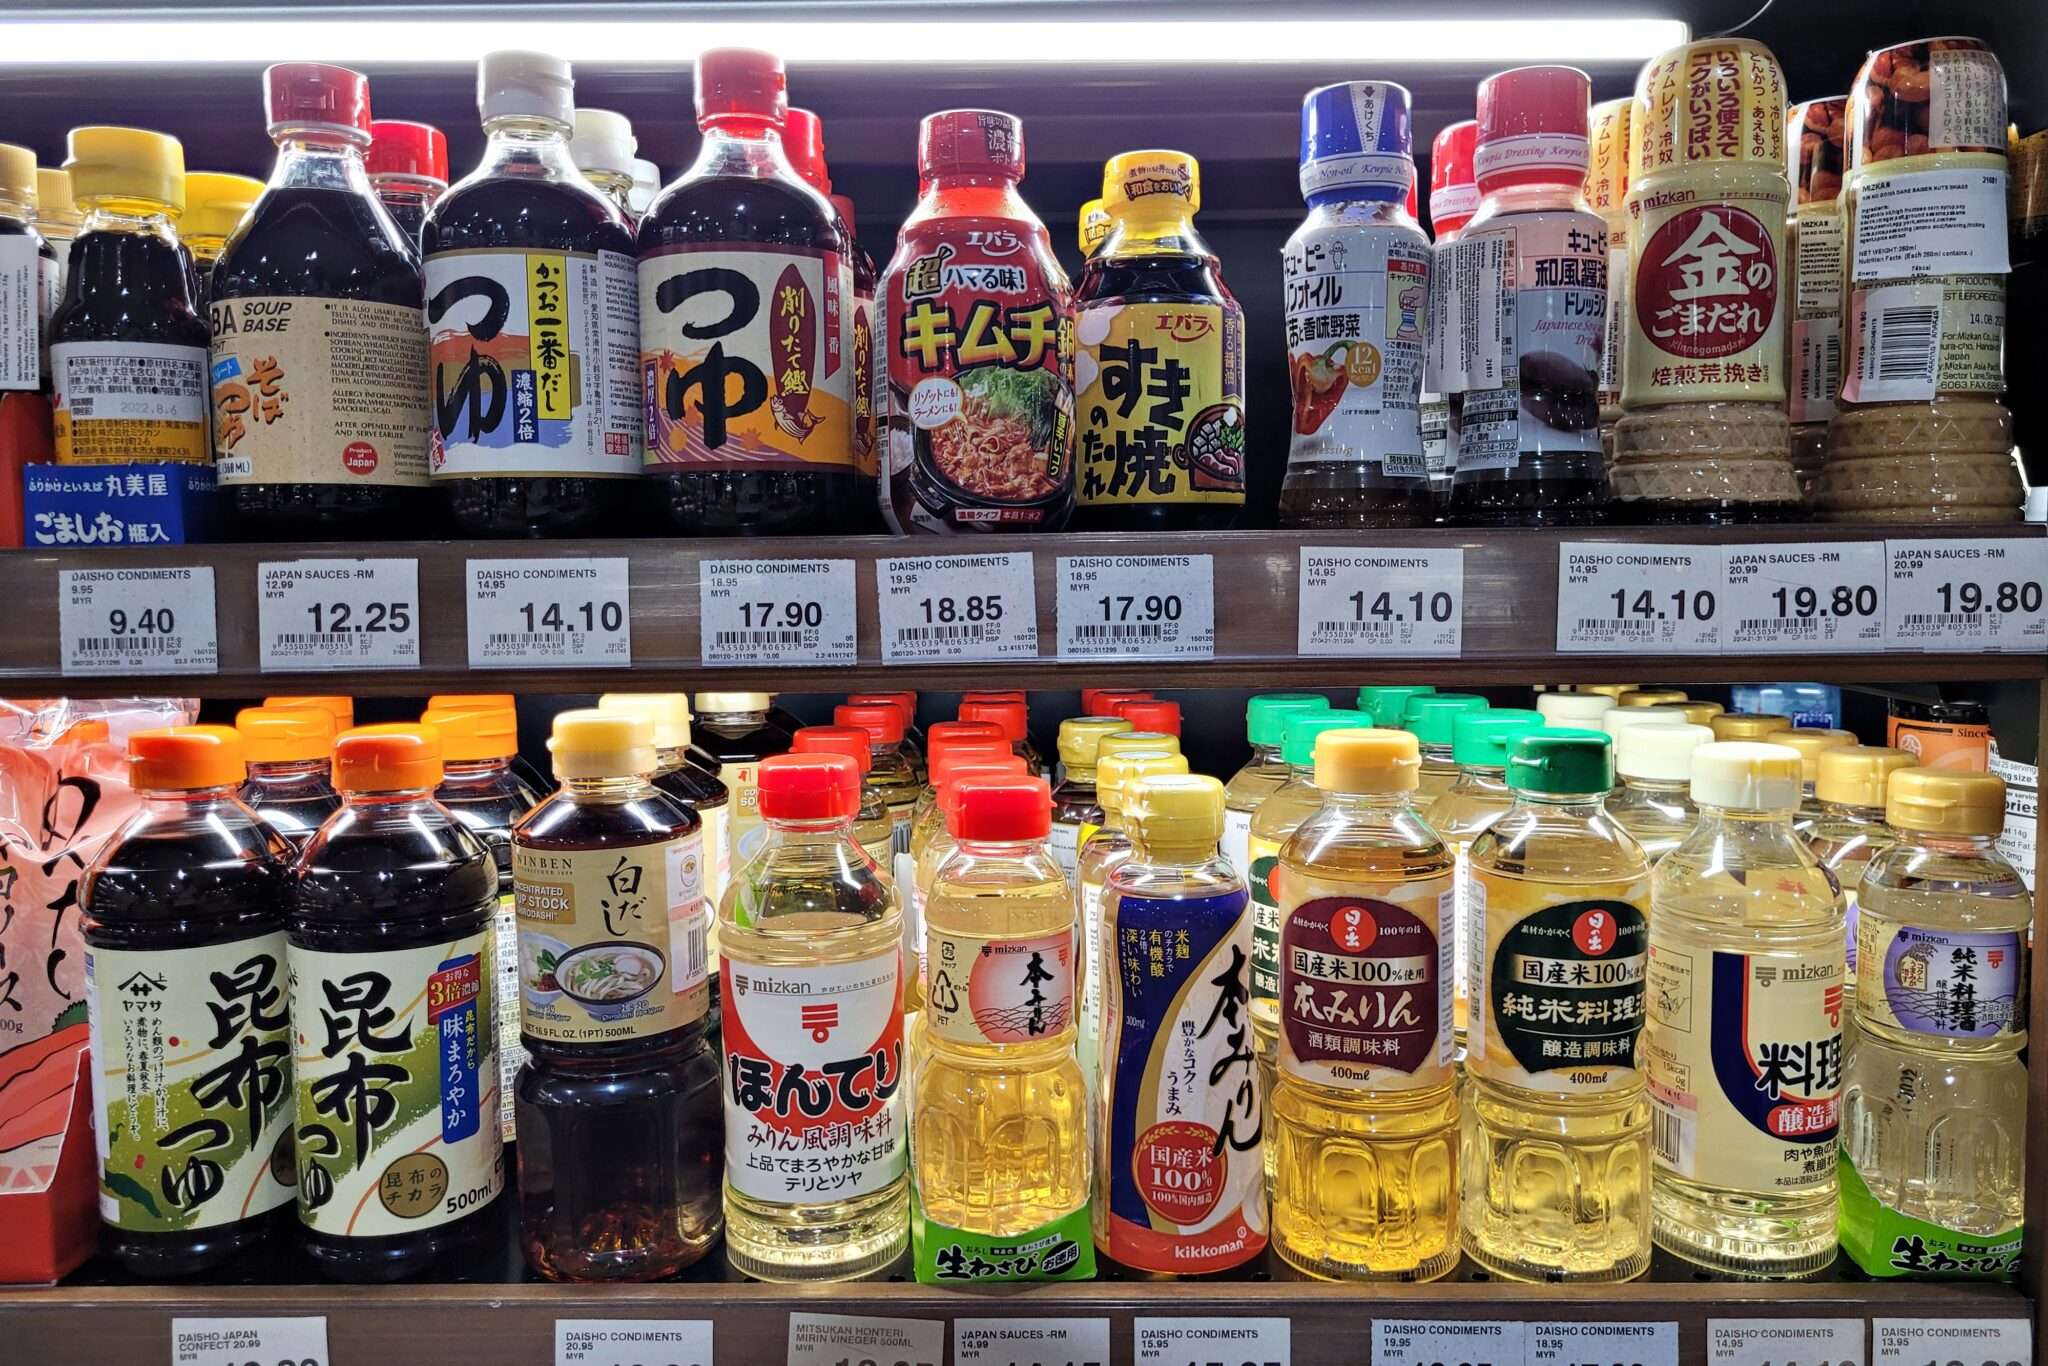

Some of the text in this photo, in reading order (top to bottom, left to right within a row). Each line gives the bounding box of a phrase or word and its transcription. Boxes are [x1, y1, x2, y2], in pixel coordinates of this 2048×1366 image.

[1688, 53, 1712, 161] コクがいっぱい
[1716, 51, 1739, 158] いろいろ使えて
[1750, 52, 1765, 158] とんかつ・あえもの
[1364, 100, 1374, 142] あけくち
[1644, 189, 1695, 209] mizkan
[966, 231, 1019, 246] エバラ
[1661, 211, 1772, 301] 金の
[243, 302, 292, 316] SOUP
[827, 276, 839, 354] 風味一番
[243, 318, 290, 332] BASE
[1155, 314, 1212, 333] エバラ
[1533, 319, 1583, 332] Japanese
[1652, 301, 1764, 337] ごまだれ
[535, 262, 565, 412] かつお一番だし
[780, 286, 810, 397] 削りたて鰹
[903, 302, 1057, 367] キムチ
[427, 276, 510, 444] つゆ
[656, 267, 768, 450] つゆ
[1353, 346, 1372, 365] 12
[1944, 352, 1970, 361] Japan
[1351, 363, 1376, 375] kcal
[1651, 363, 1762, 386] 焙煎荒挽き
[247, 356, 289, 425] そば
[332, 390, 363, 399] ALLERGY
[914, 387, 958, 406] リゾットにも!
[120, 401, 177, 416] 2022.8.6
[515, 372, 534, 441] 濃縮2倍
[914, 404, 957, 420] ラーメンにも!
[347, 457, 376, 468] Japan
[29, 474, 169, 497] ふりかけといえば 丸美屋
[34, 512, 170, 545] ごましお 瓶入
[1070, 557, 1190, 568] DAISHO CONDIMENTS
[1569, 555, 1692, 565] DAISHO CONDIMENTS
[1729, 555, 1766, 564] JAPAN
[1769, 553, 1815, 563] SAUCES
[1894, 550, 1931, 559] JAPAN
[1934, 549, 1980, 559] SAUCES
[710, 564, 830, 574] DAISHO CONDIMENTS
[890, 557, 1009, 571] DAISHO CONDIMENTS
[1308, 558, 1428, 568] DAISHO CONDIMENTS
[1569, 566, 1598, 574] 14.95
[1729, 566, 1758, 575] 20.99
[1894, 561, 1923, 569] 20.99
[72, 570, 191, 581] DAISHO CONDIMENTS
[265, 570, 301, 579] JAPAN
[305, 570, 350, 579] SAUCES
[477, 569, 597, 579] DAISHO CONDIMENTS
[890, 575, 918, 584] 19.95
[1070, 572, 1097, 581] 18.95
[1308, 568, 1336, 577] 14.95
[72, 585, 93, 594] 9.95
[266, 581, 293, 589] 12.99
[478, 581, 505, 589] 14.95
[711, 578, 738, 587] 18.95
[1611, 589, 1715, 621] 14.10
[1772, 585, 1878, 618] 19.80
[1937, 582, 2043, 613] 19.80
[739, 602, 822, 628] 17.90
[920, 595, 1002, 623] 18.85
[1099, 595, 1182, 621] 17.90
[1350, 591, 1452, 622] 14.10
[110, 608, 175, 635] 9.40
[308, 602, 410, 633] 12.25
[520, 602, 622, 632] 14.10
[1957, 727, 1986, 739] Since
[2012, 828, 2027, 838] 14g
[528, 896, 569, 910] STOCK
[600, 856, 647, 937] 白だし
[1175, 929, 1190, 960] 米麹
[1911, 932, 1949, 945] mizkan
[995, 945, 1027, 954] mizkan
[1149, 929, 1165, 978] 有機酸
[1126, 928, 1143, 998] 深い味わい
[1294, 950, 1424, 982] 国産米100%使用
[1782, 963, 1834, 981] mizkan
[429, 980, 481, 1008] 3倍濃縮
[753, 978, 811, 995] mizkan
[1949, 946, 1978, 1034] 純米料理酒
[122, 999, 162, 1013] ヤマサ
[1293, 981, 1421, 1029] 本みりん
[465, 1008, 476, 1071] 昆布だから
[605, 1026, 636, 1037] 500ML
[1308, 1031, 1401, 1056] 酒類調味料
[1542, 1036, 1631, 1059] 醸造調味料
[1181, 1020, 1198, 1094] 豊かなコクと
[442, 1013, 466, 1130] 味まろやか
[729, 1040, 902, 1116] ほんてり
[1166, 1071, 1181, 1116] うまみ
[747, 1109, 893, 1151] みりん風調味料
[746, 1138, 896, 1172] 上品でまろやかな甘味
[1150, 1144, 1213, 1168] 国産米
[785, 1171, 863, 1192] テリとツヤ
[1151, 1167, 1212, 1191] 100%
[446, 1180, 492, 1214] 500ml
[1175, 1238, 1243, 1259] kikkoman
[1890, 1234, 2005, 1273] 生わさび
[936, 1244, 1040, 1280] 生わさび
[179, 1330, 257, 1342] DAISHO JAPAN
[566, 1332, 682, 1341] DAISHO CONDIMENTS
[797, 1325, 904, 1337] MITSUKAN HONTERI
[962, 1331, 996, 1339] JAPAN
[1000, 1330, 1043, 1339] SAUCES
[1141, 1330, 1258, 1339] DAISHO CONDIMENTS
[1384, 1325, 1502, 1335] DAISHO CONDIMENTS
[1536, 1326, 1655, 1336] DAISHO CONDIMENTS
[1715, 1329, 1834, 1338] DAISHO CONDIMENTS
[1881, 1327, 2000, 1337] DAISHO CONDIMENTS
[179, 1340, 260, 1351] CONFECT 20.99
[566, 1342, 593, 1350] 20.95
[797, 1334, 912, 1347] MIRIN VINEGER 500ML
[962, 1340, 988, 1348] 14.99
[1141, 1340, 1169, 1348] 15.95
[1384, 1338, 1411, 1347] 19.95
[1536, 1340, 1563, 1349] 18.95
[1716, 1339, 1743, 1348] 14.95
[1881, 1338, 1909, 1346] 13.95
